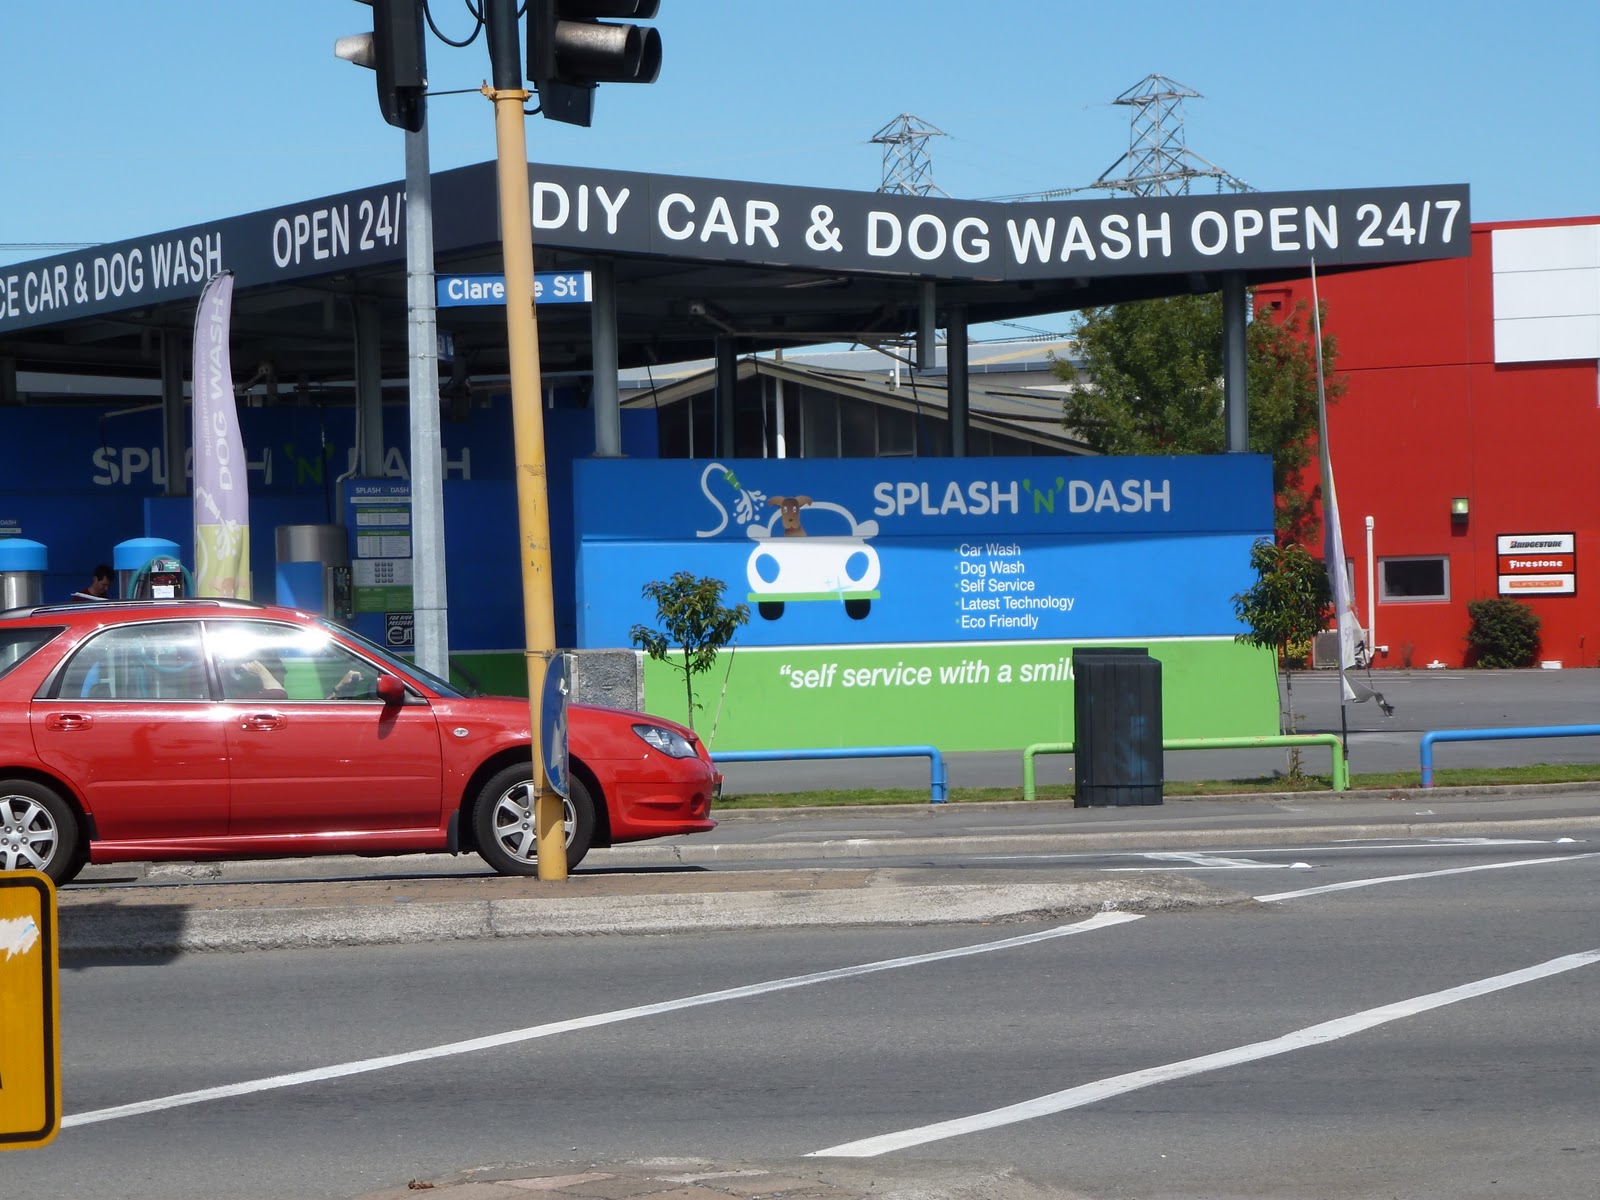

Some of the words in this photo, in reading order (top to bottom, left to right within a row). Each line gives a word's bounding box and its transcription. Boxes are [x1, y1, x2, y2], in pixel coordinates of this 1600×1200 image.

[532, 182, 630, 234] DIY
[658, 192, 780, 248] CAR
[805, 204, 843, 252] &
[866, 211, 990, 263] DOG
[1007, 211, 1171, 264] WASH
[1191, 204, 1338, 256] OPEN
[1356, 200, 1461, 247] 24/7
[24, 265, 69, 314] CAR
[74, 262, 88, 304] &
[94, 248, 144, 301] DOG
[151, 232, 222, 289] WASH
[273, 204, 349, 268] OPEN
[359, 192, 407, 250] 24/
[448, 278, 544, 300] Claree
[553, 275, 577, 297] St
[209, 297, 225, 400] WASH
[213, 410, 233, 491] DOG
[873, 481, 1019, 516] SPLASH
[1068, 479, 1171, 513] DASH
[960, 543, 982, 557] Car
[986, 543, 1021, 557] Wash
[960, 561, 986, 577] Dog
[989, 560, 1025, 574] Wash
[1509, 560, 1563, 569] Firestone
[961, 579, 986, 592] Self
[988, 578, 1035, 592] Service
[961, 597, 1000, 610] Latest
[1003, 595, 1075, 611] Technology
[961, 615, 986, 628] Eco
[989, 614, 1039, 630] Friendly
[842, 661, 932, 687] service
[940, 659, 991, 684] with
[997, 664, 1012, 683] a
[1020, 657, 1075, 682] smil
